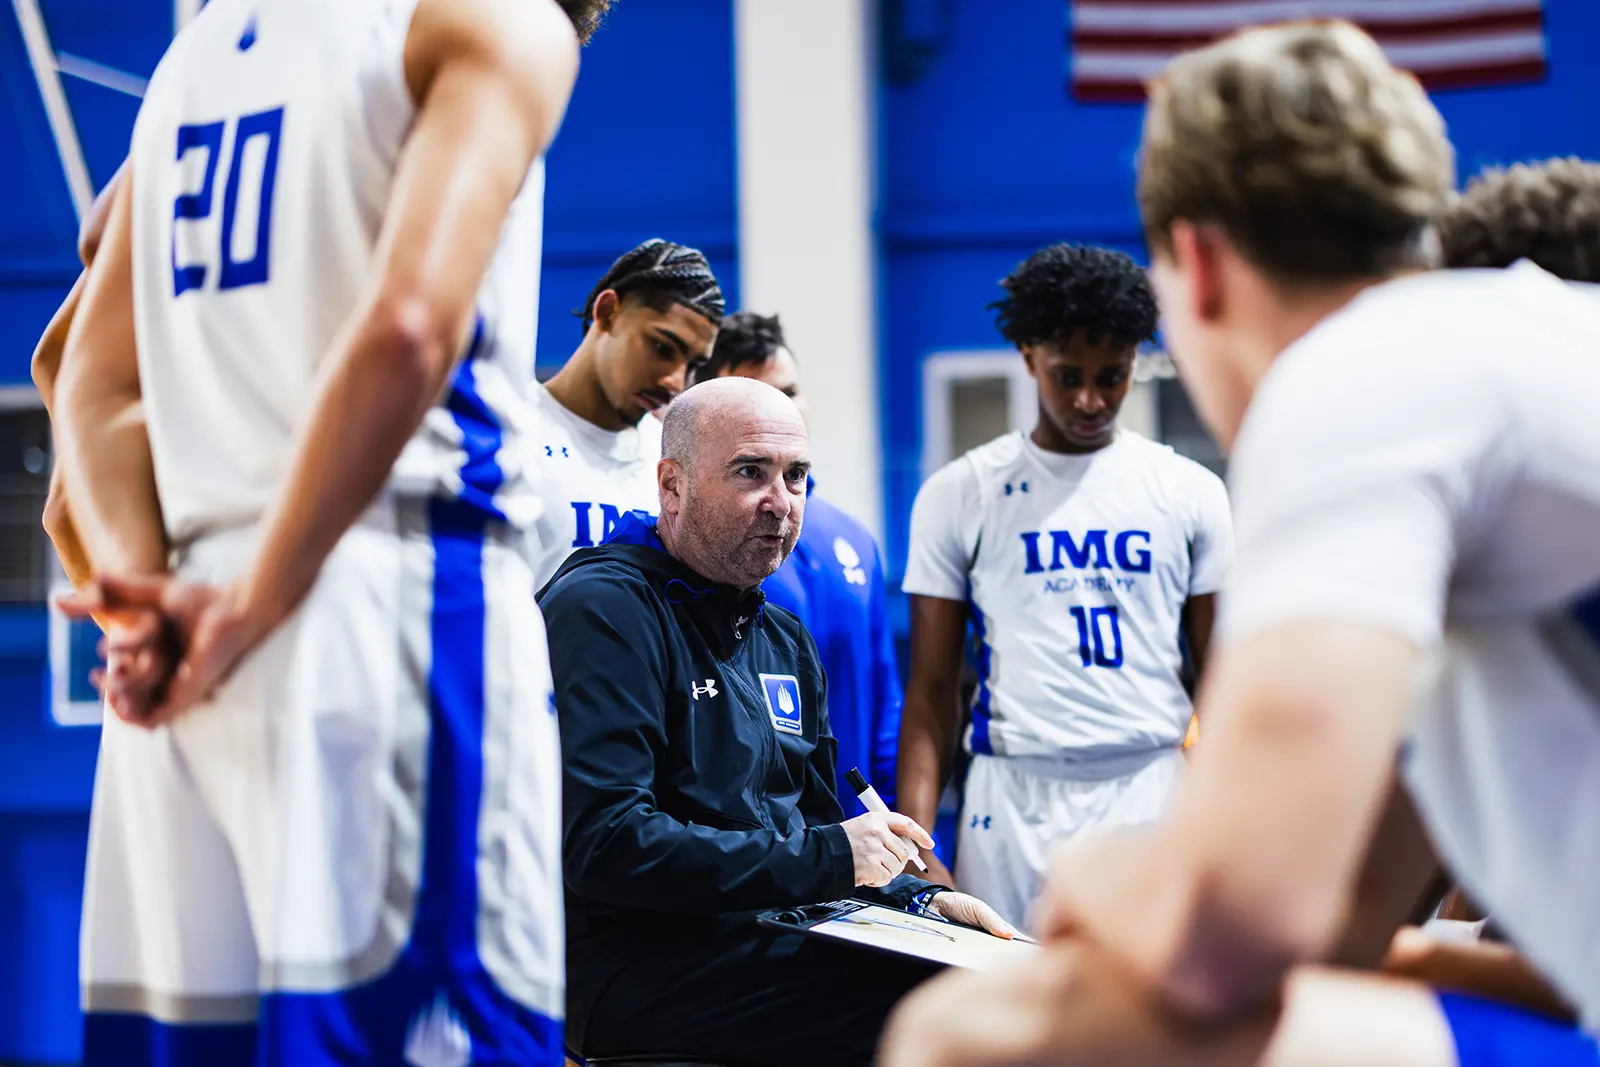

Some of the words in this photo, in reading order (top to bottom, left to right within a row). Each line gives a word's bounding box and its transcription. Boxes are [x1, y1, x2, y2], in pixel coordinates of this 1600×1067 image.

[173, 105, 284, 298] 20
[570, 502, 649, 547] IM
[1020, 530, 1151, 574] IMG
[1069, 605, 1124, 668] 10
